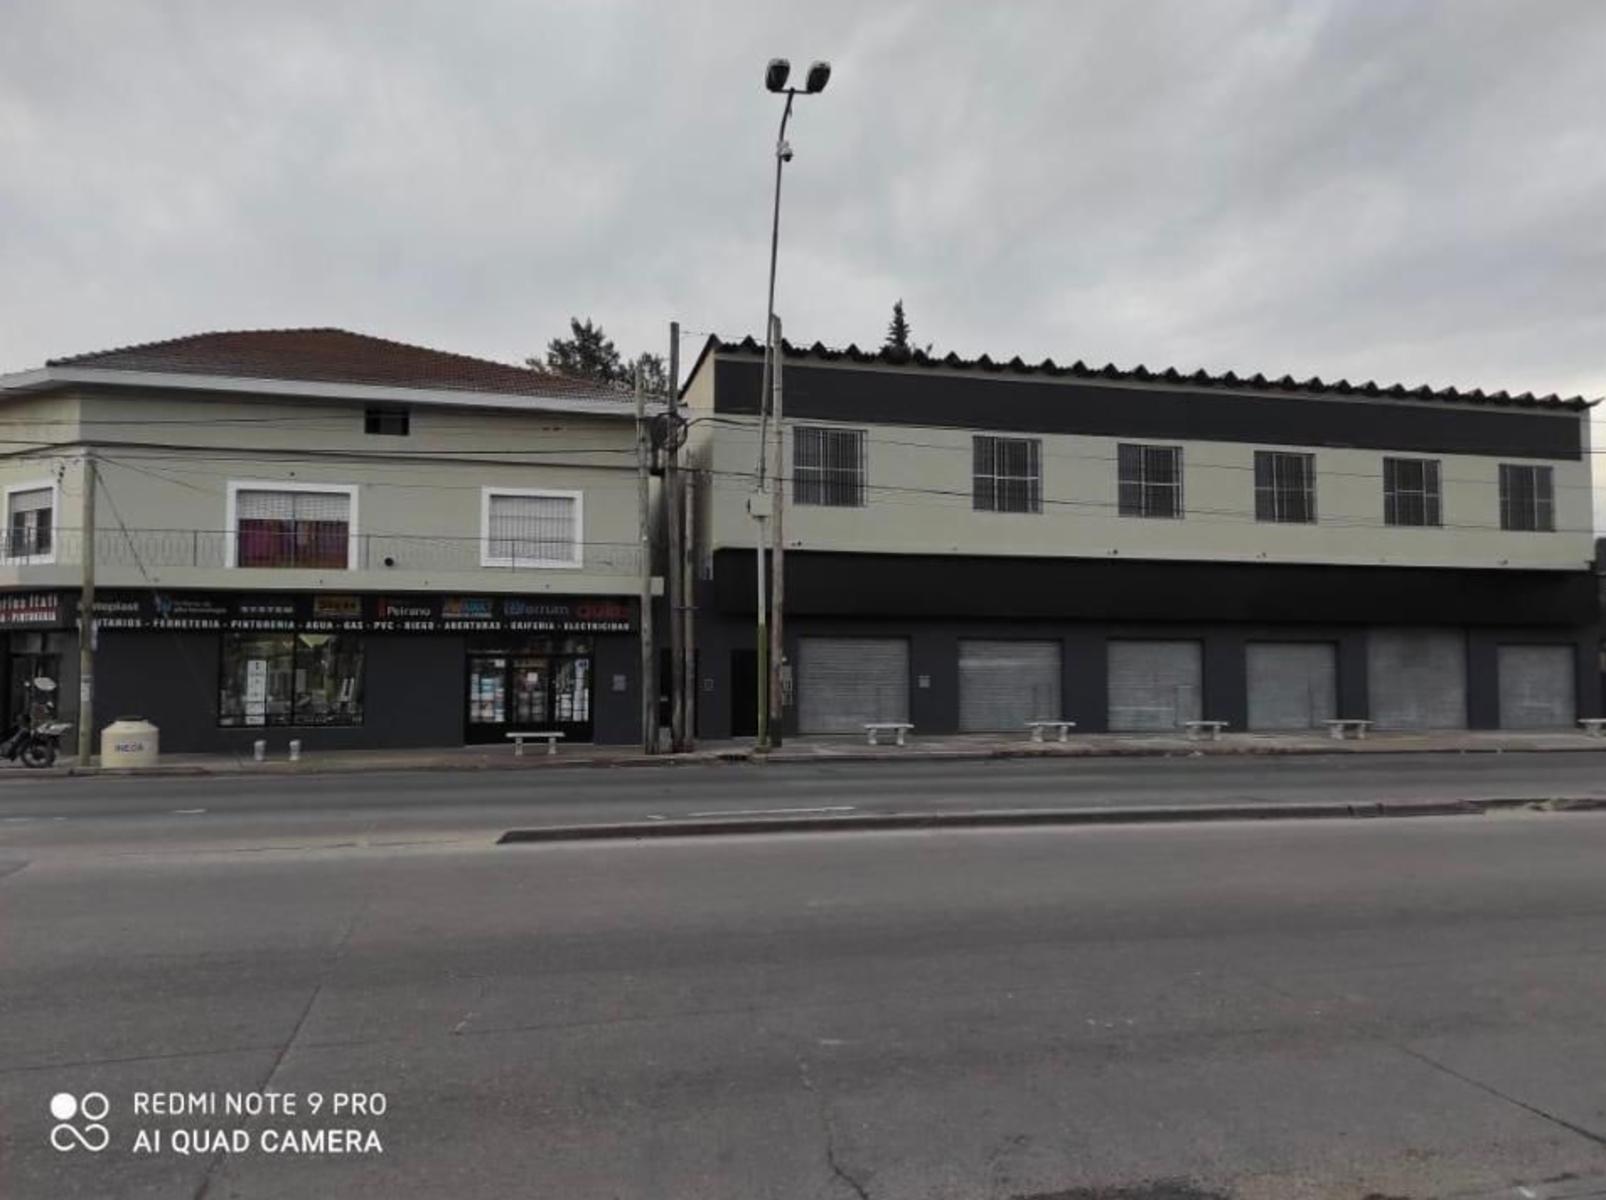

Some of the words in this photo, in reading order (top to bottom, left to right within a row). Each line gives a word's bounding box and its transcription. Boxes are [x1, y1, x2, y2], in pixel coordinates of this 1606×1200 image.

[305, 621, 334, 629] AGUA
[343, 621, 364, 630] GAS
[373, 621, 395, 630] PVC
